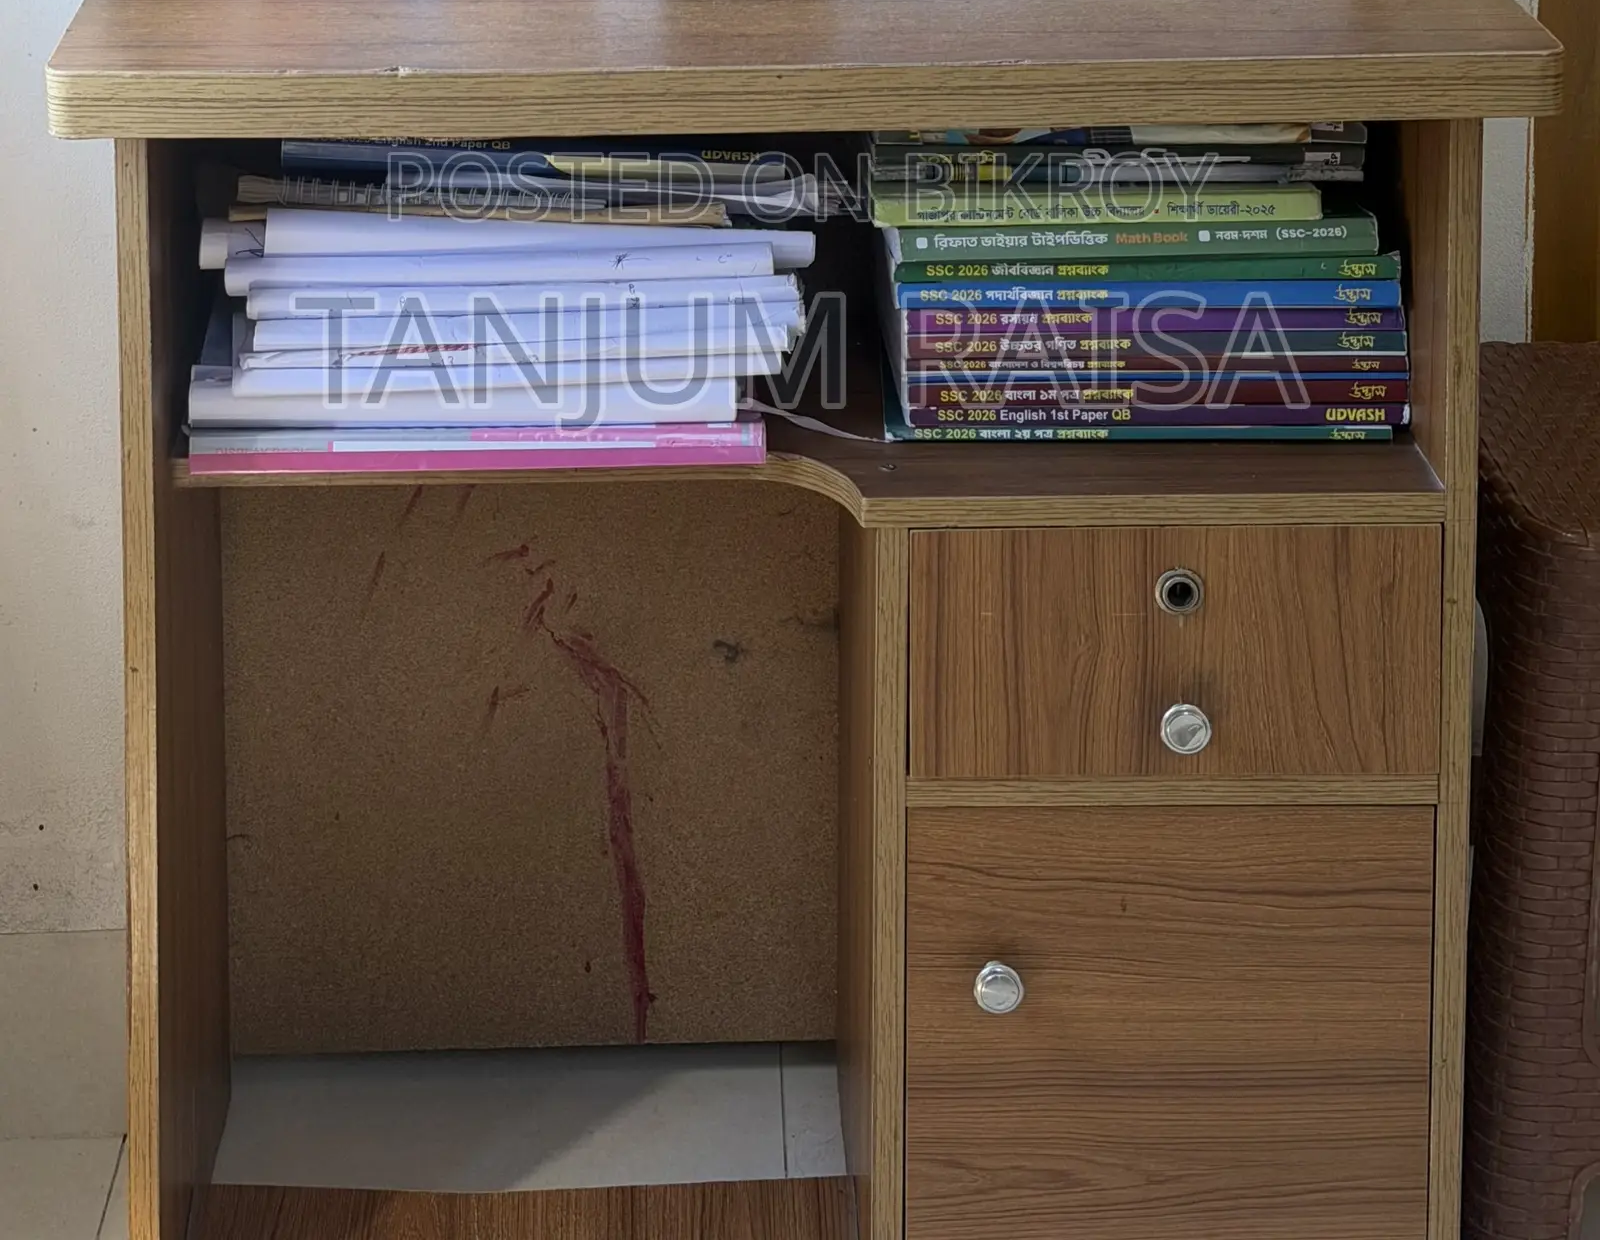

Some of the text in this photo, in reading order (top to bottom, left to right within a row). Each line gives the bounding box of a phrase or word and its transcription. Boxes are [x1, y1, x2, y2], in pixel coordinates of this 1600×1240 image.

[492, 141, 511, 150] QB
[934, 234, 978, 249] রিফাত
[980, 233, 1028, 248] ভাইয়ার
[1032, 231, 1109, 247] টাইপভিত্তিক
[1116, 232, 1150, 243] Math
[1153, 231, 1188, 243] Book
[1276, 225, 1348, 241] (SSC-2026)
[926, 262, 1110, 277] SSC 2026 জীববিজ্ঞান প্রশ্নব্যাংক
[1338, 260, 1378, 278] উদ্ভাস
[920, 290, 949, 302] SSC
[951, 290, 983, 301] 2026
[985, 286, 1054, 301] পদার্থবিজ্ঞান
[1333, 284, 1373, 303] উদ্ভাস
[935, 313, 963, 325] SSC
[967, 313, 998, 325] 2026
[1000, 313, 1038, 325] রসায়ন
[935, 341, 963, 353] SSC
[967, 340, 997, 352] 2026
[963, 360, 987, 369] 2026
[940, 390, 968, 402] SSC
[972, 390, 1003, 402] 2026
[1005, 389, 1037, 401] বাংলা
[1040, 390, 1058, 401] ১ম
[1349, 381, 1388, 400] উদ্ভাস
[937, 409, 1132, 423] SSC 2026 English 1st Paper QB
[1325, 408, 1386, 422] UDVASH
[914, 428, 942, 439] SSC
[945, 428, 977, 439] 2026
[979, 428, 1012, 440] বাংলা
[1034, 428, 1053, 439] পত্র
